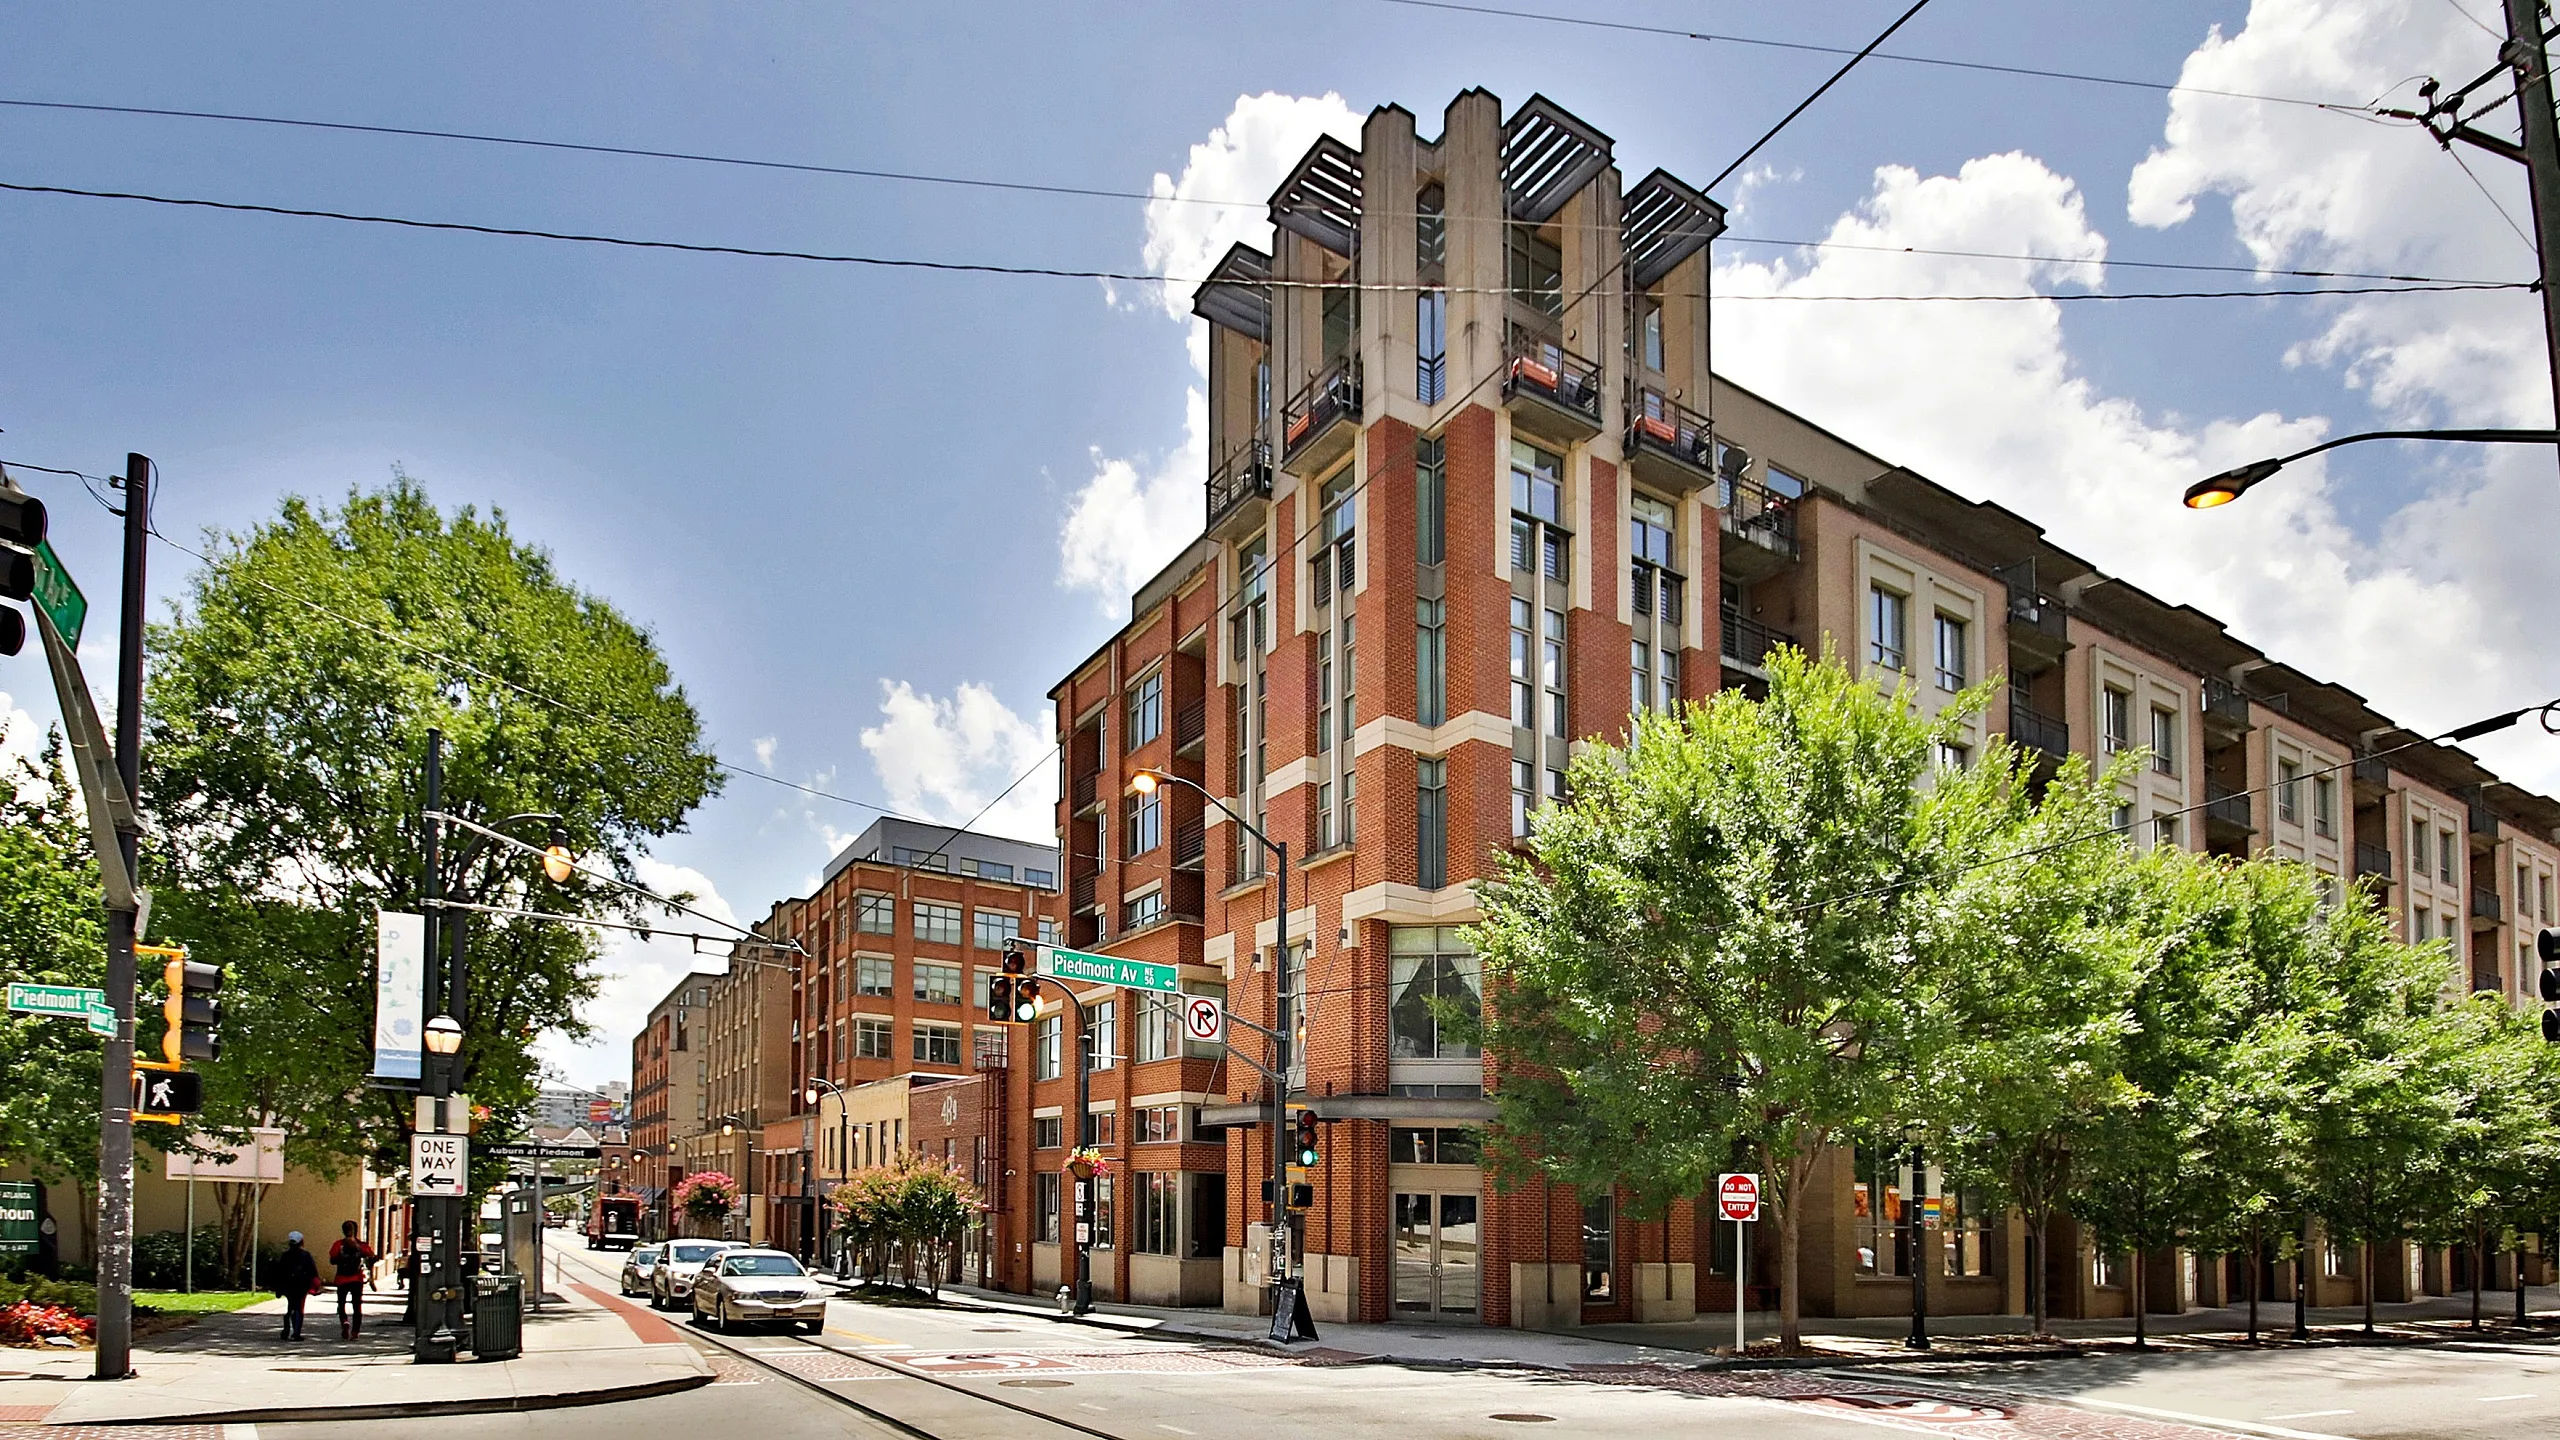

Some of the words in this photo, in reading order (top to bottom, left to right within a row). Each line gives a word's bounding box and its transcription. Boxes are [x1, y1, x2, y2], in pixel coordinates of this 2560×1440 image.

[1054, 954, 1115, 979] Piedmont
[1121, 965, 1137, 982] Av
[1144, 967, 1154, 976] NE
[1144, 977, 1155, 986] 50
[14, 987, 82, 1010] Piedmont
[84, 992, 100, 1002] AVE
[421, 1140, 455, 1154] ONE
[489, 1147, 524, 1155] Auburn
[540, 1147, 585, 1156] Piedmont
[421, 1157, 456, 1169] WAY
[1725, 1183, 1735, 1191] DO
[1728, 1203, 1750, 1211] ENTER
